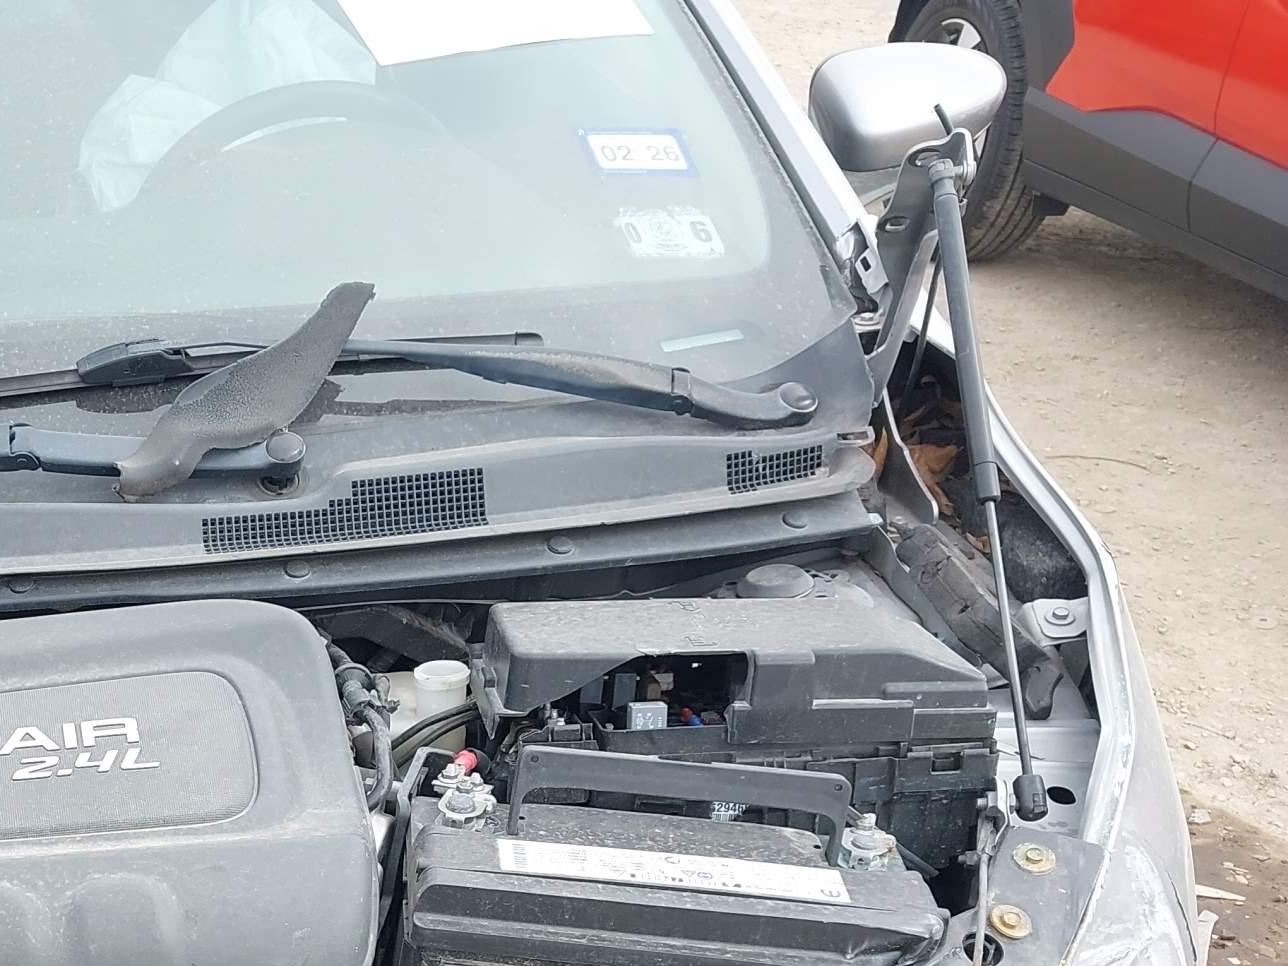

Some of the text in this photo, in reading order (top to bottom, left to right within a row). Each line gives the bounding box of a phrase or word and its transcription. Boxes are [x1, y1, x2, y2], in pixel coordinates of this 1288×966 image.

[600, 144, 680, 162] 02 26
[11, 747, 161, 782] 2.4L
